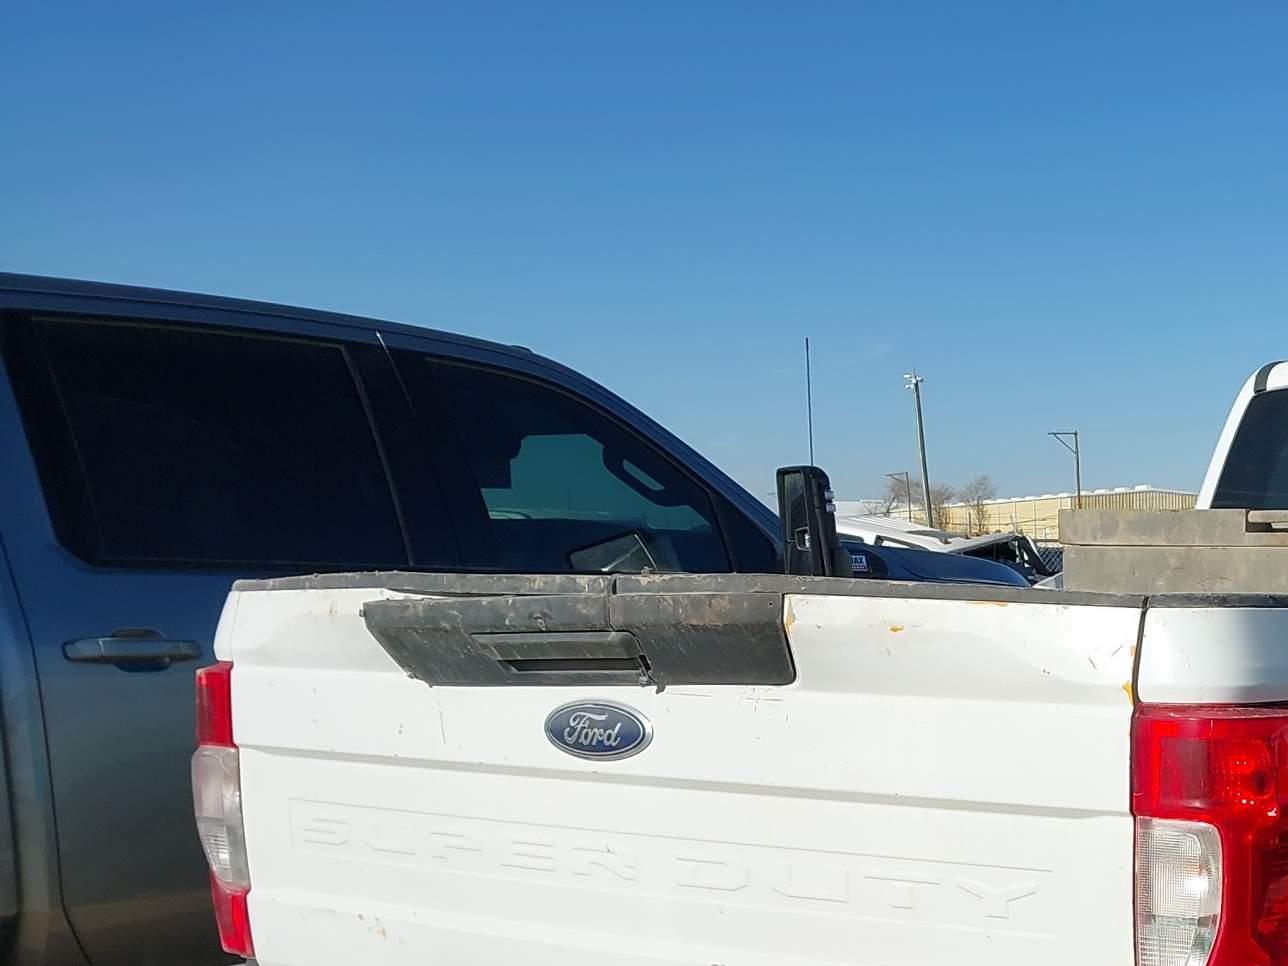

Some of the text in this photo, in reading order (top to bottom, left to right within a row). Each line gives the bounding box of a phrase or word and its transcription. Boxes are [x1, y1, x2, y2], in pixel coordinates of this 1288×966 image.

[563, 711, 622, 747] Ford
[300, 816, 1039, 920] SUPER DUTY
